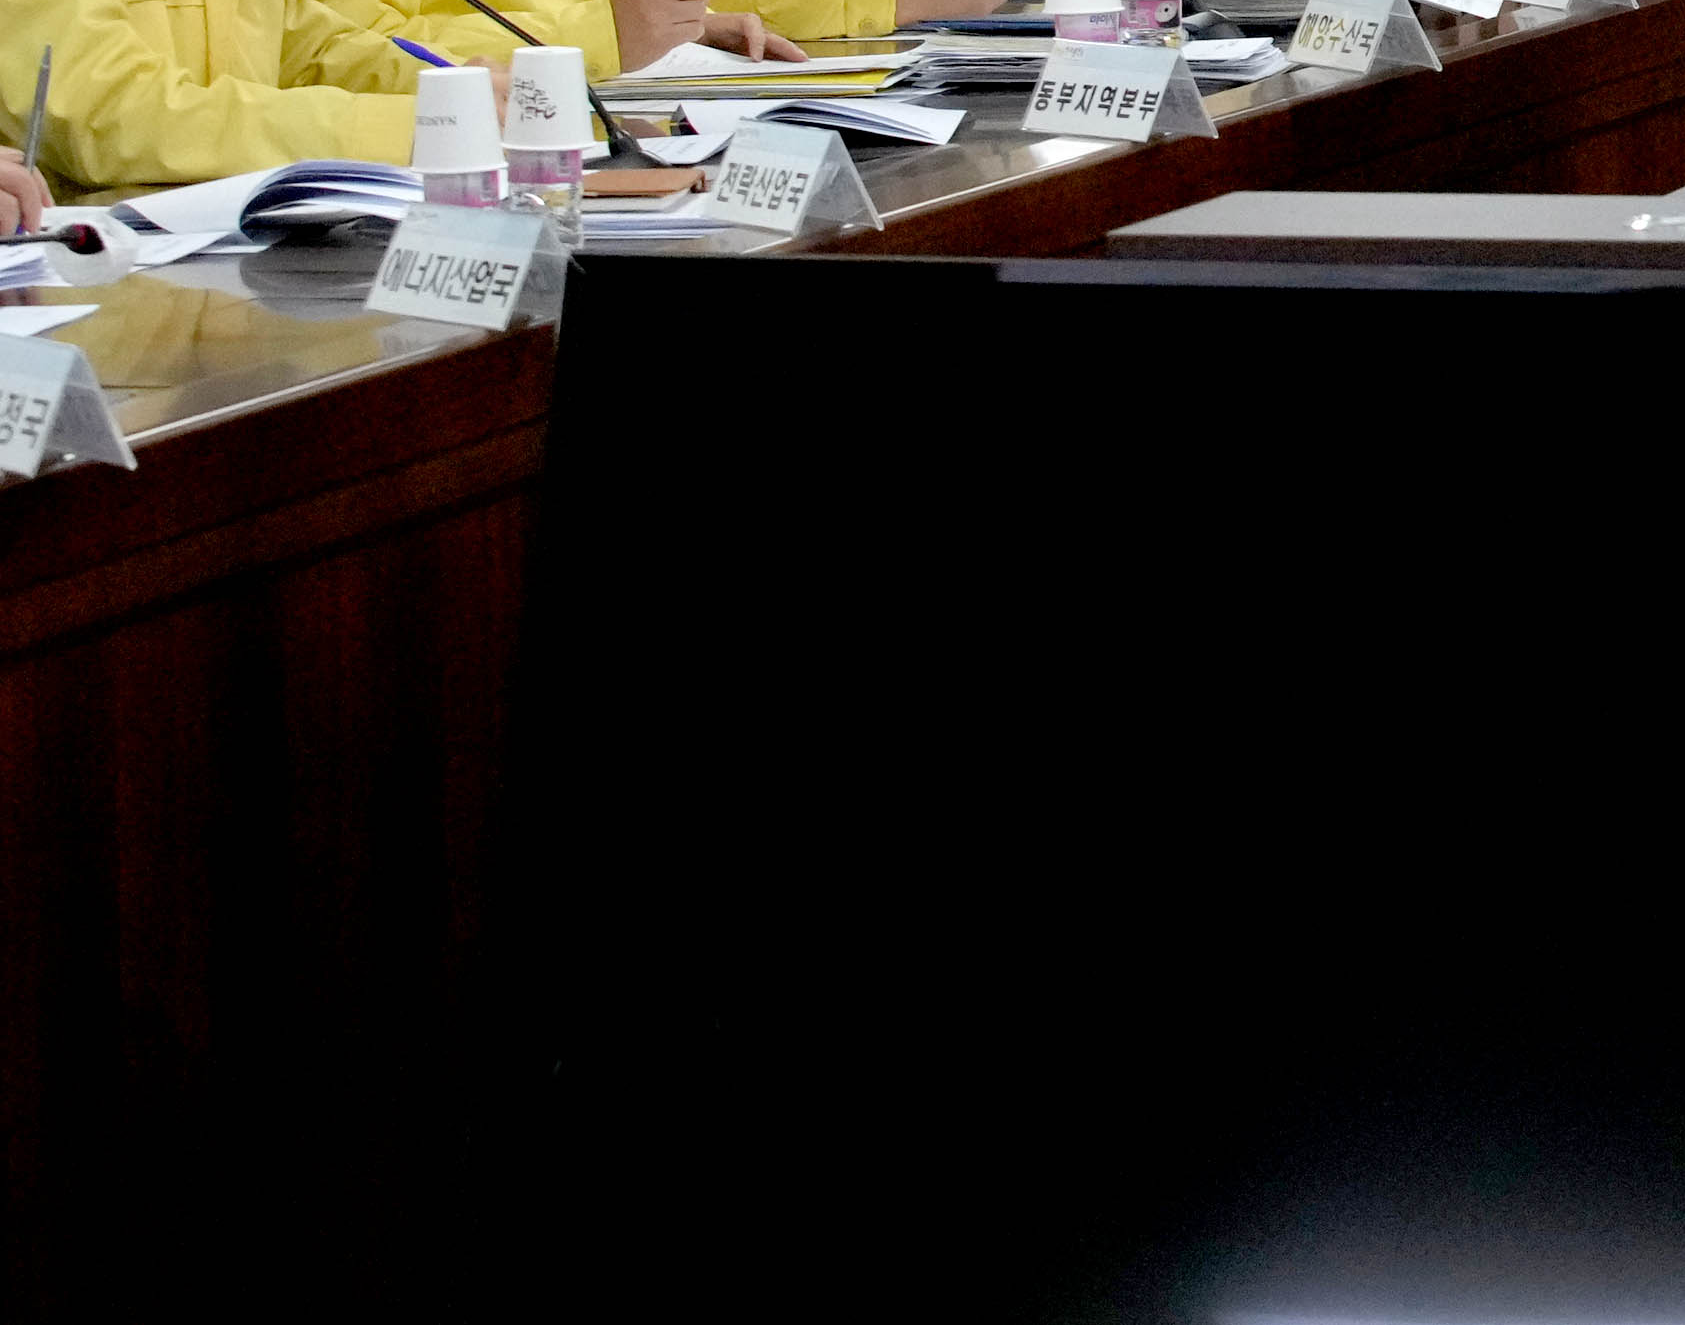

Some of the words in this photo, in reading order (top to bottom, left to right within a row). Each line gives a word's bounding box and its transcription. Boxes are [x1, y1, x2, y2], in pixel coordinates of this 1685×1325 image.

[1298, 12, 1379, 57] 해양수산국
[1035, 80, 1160, 121] 동부지역본부
[717, 162, 809, 213] 전략산업국
[381, 248, 520, 307] 에너지산업국
[0, 391, 49, 448] 정국
